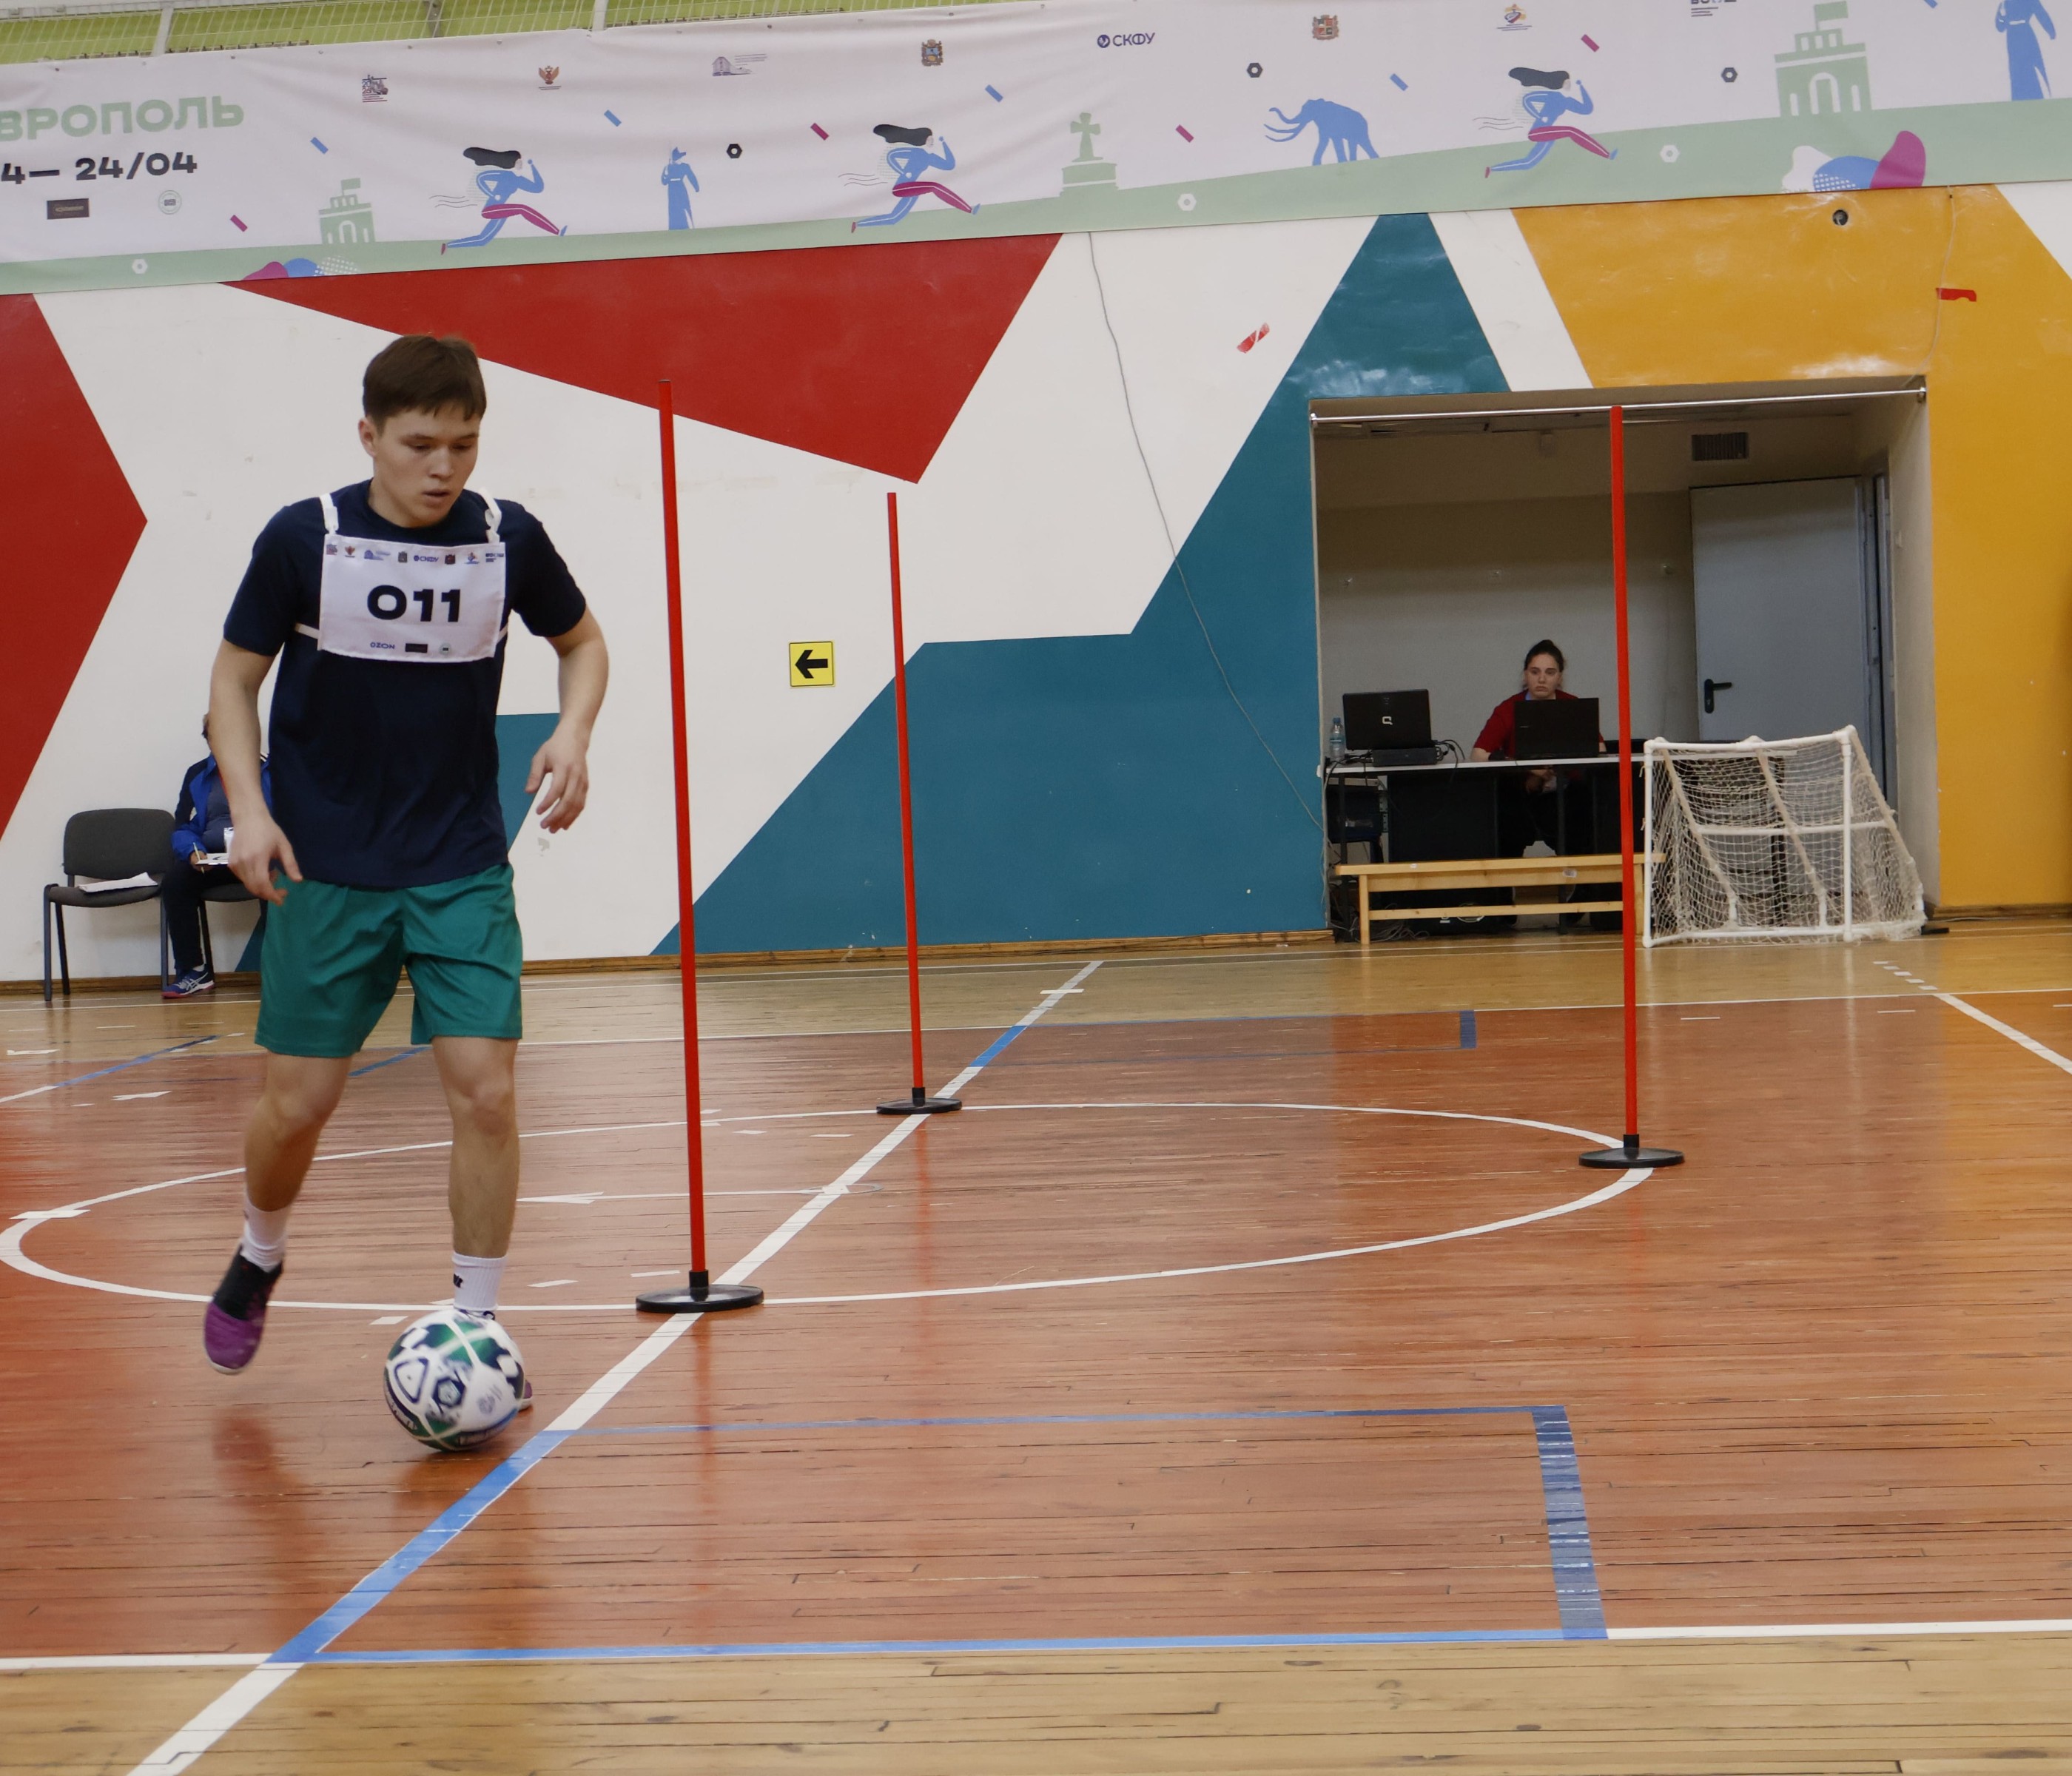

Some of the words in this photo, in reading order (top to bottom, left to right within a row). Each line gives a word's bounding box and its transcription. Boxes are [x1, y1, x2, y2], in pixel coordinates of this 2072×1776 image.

[1112, 32, 1156, 47] СКФУ
[0, 96, 244, 141] ВРОПОЛЬ
[75, 151, 198, 180] 24/04
[367, 585, 460, 622] 011
